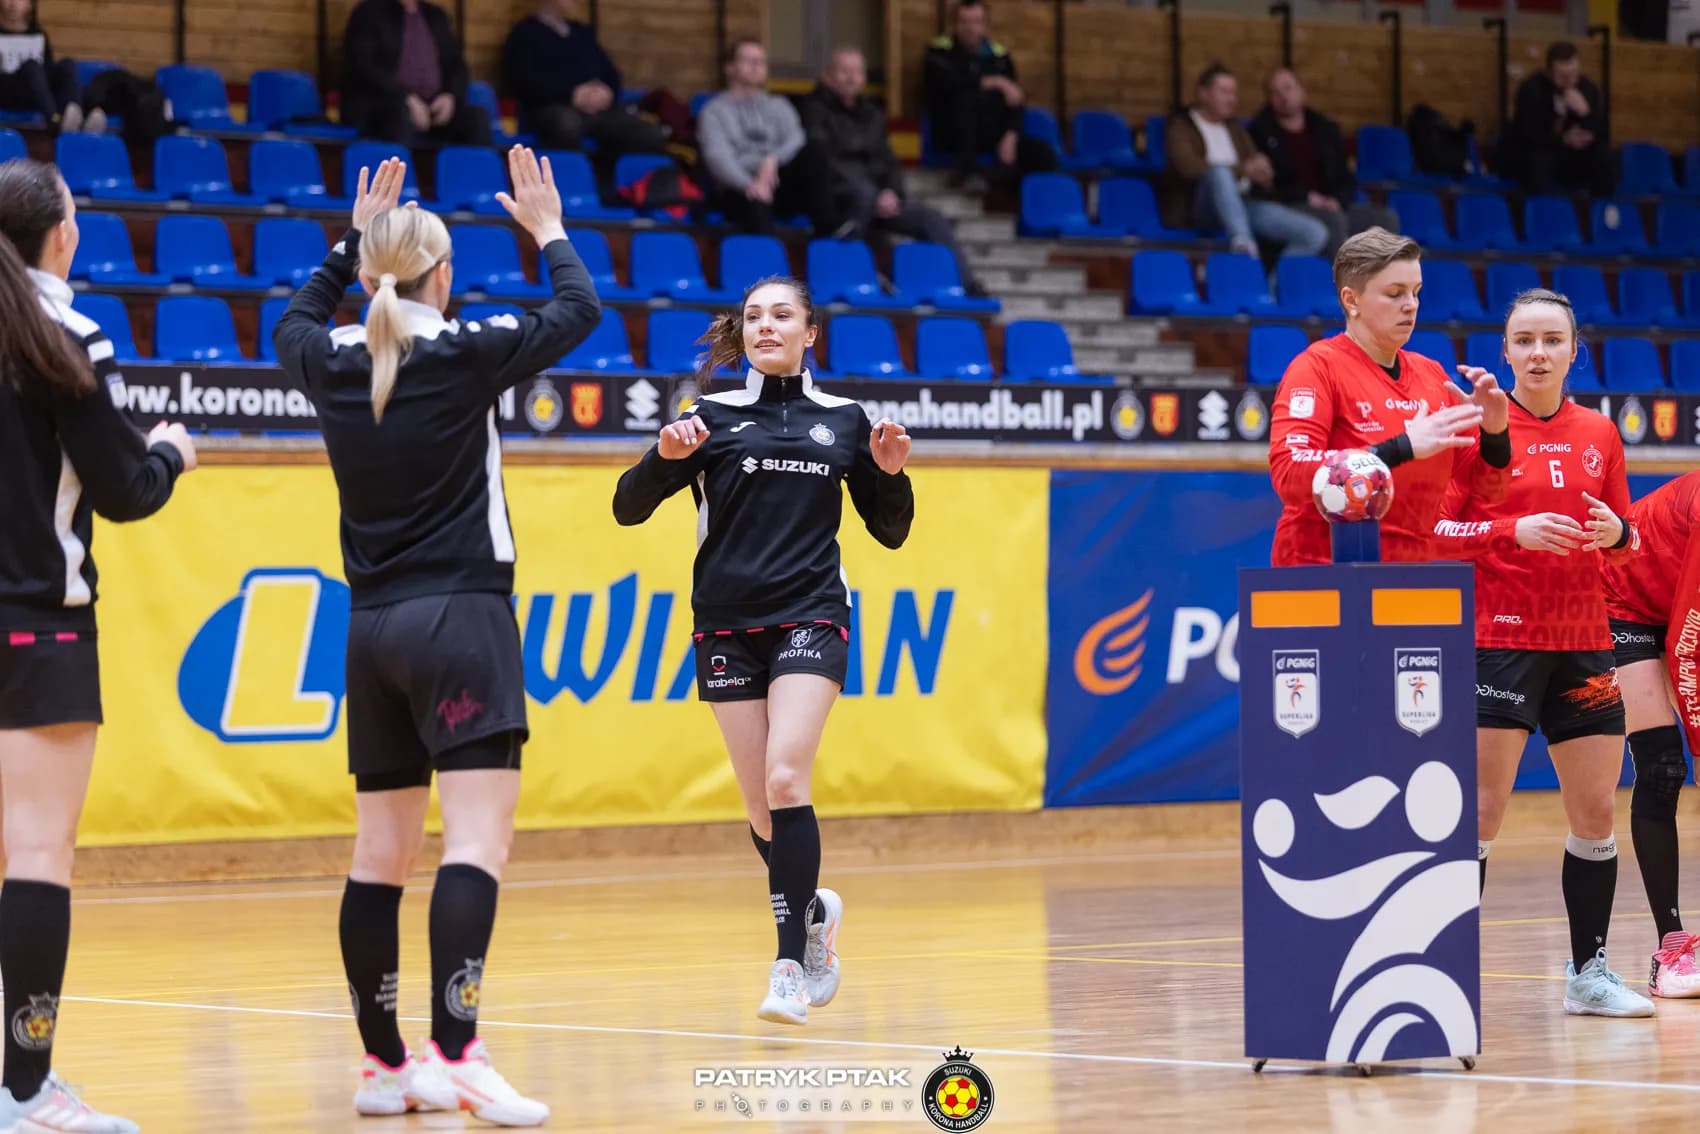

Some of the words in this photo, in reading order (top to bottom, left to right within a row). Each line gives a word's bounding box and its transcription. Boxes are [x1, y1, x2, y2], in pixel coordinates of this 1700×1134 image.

[1539, 443, 1572, 454] PGNiG
[761, 458, 830, 476] SUZUKI
[1549, 459, 1565, 489] 6
[778, 648, 822, 661] PROFIKA
[1489, 685, 1526, 704] hosteye
